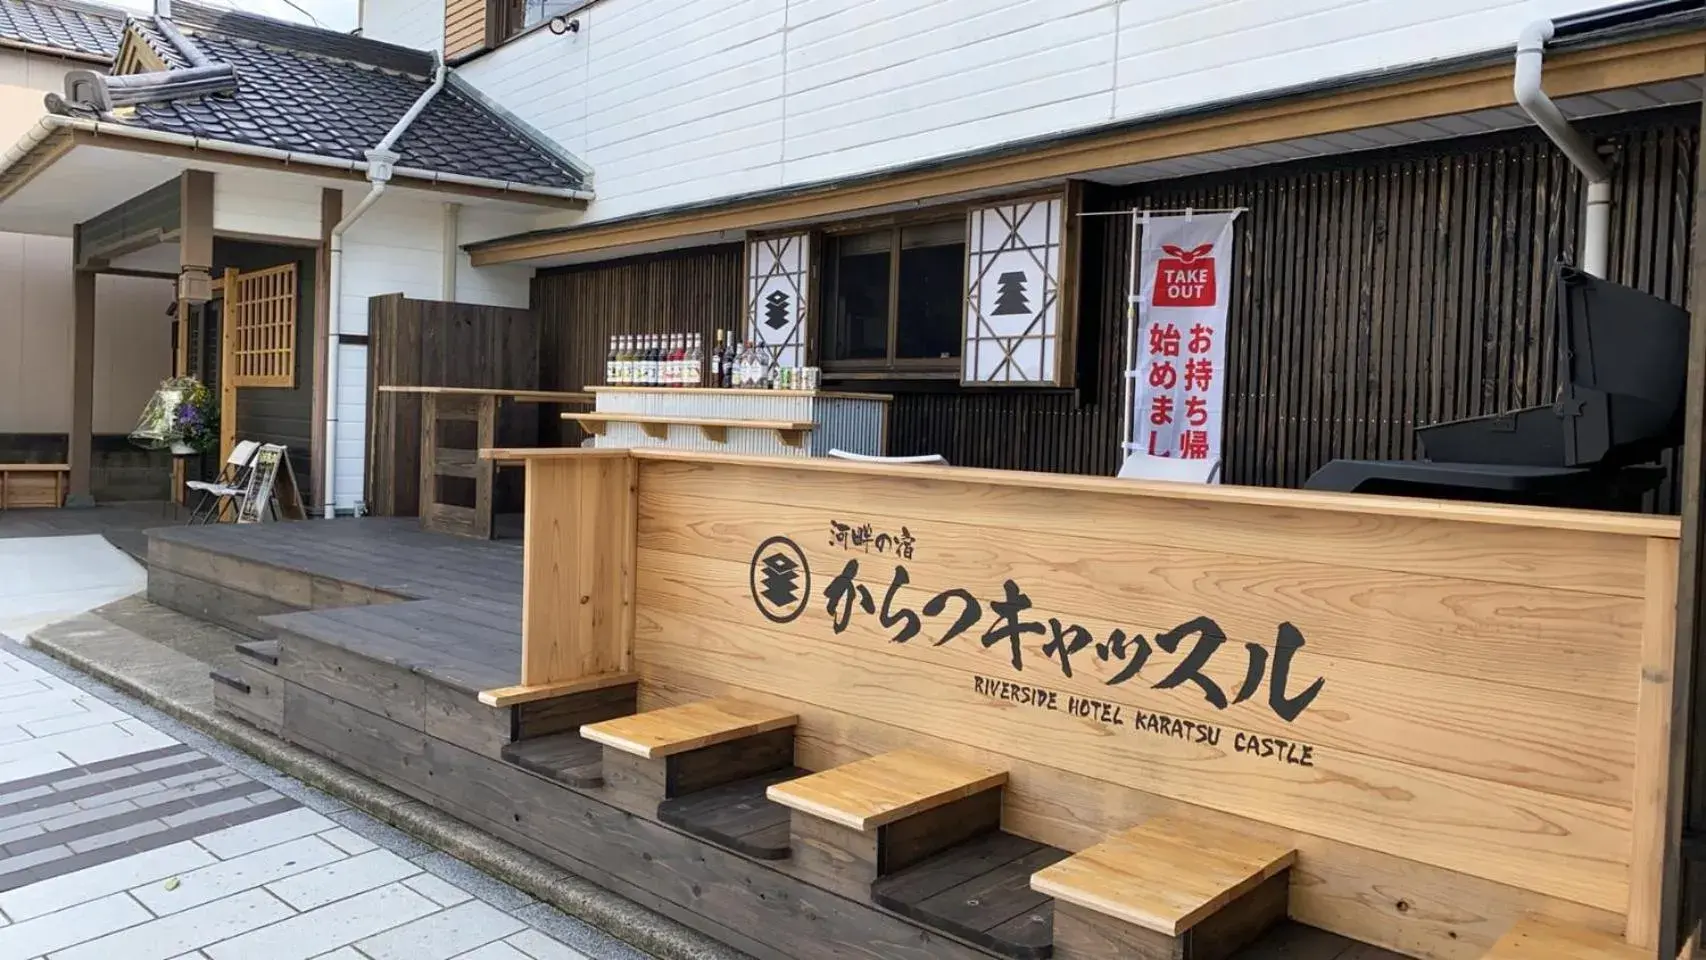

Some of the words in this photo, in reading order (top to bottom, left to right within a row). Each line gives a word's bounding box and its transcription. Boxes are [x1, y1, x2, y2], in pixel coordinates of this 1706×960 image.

[1164, 269, 1208, 284] TAKE
[1167, 284, 1204, 299] OUT
[829, 519, 916, 560] 河畔の宿
[824, 559, 1325, 722] からつキャッスル
[974, 675, 1058, 710] RIVERSIDE
[1068, 697, 1123, 725] HOTEL
[1135, 710, 1222, 746] KARATSU
[1234, 732, 1314, 767] CASTLE
